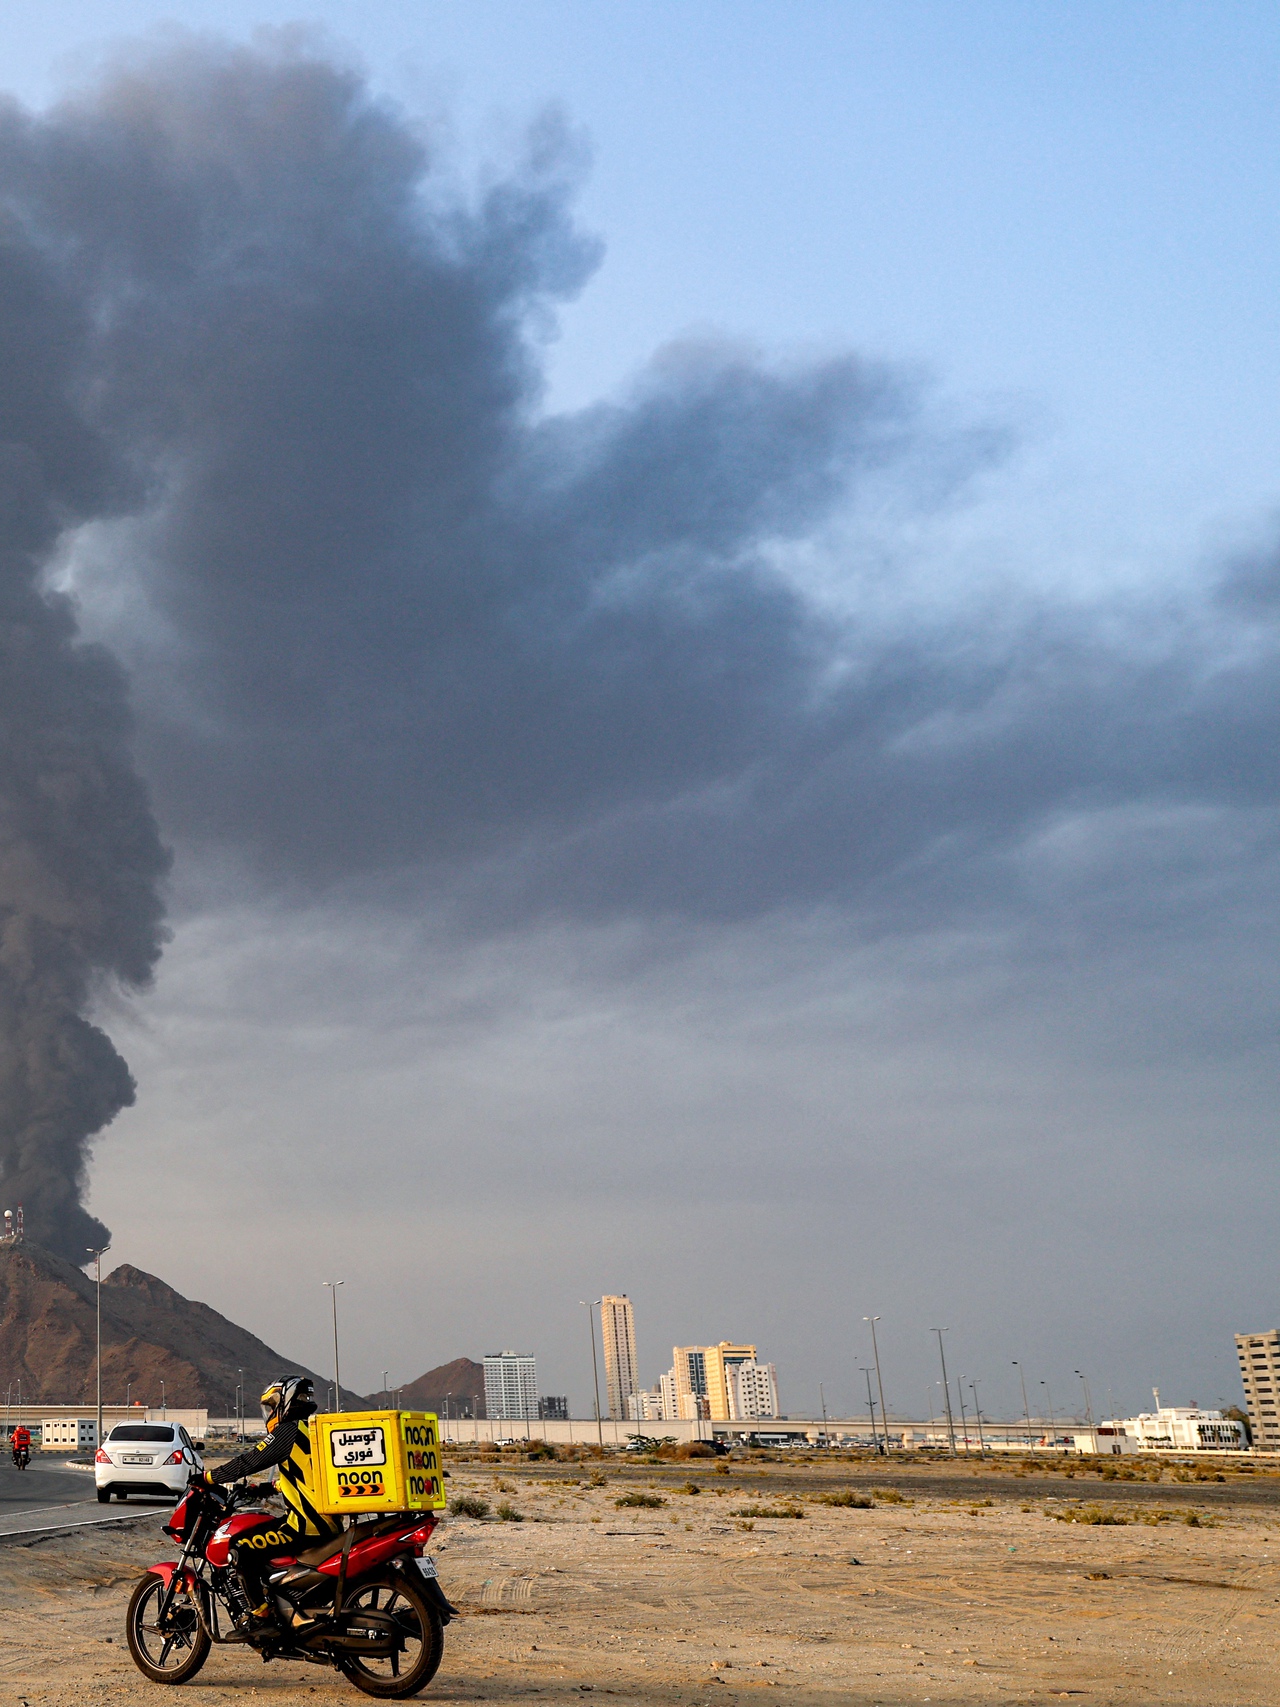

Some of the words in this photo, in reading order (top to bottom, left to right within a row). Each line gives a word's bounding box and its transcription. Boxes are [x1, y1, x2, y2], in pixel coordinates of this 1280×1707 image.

[338, 1430, 377, 1446] توصيل
[344, 1447, 373, 1464] فوري
[337, 1470, 383, 1486] noon
[237, 1530, 294, 1549] noon
